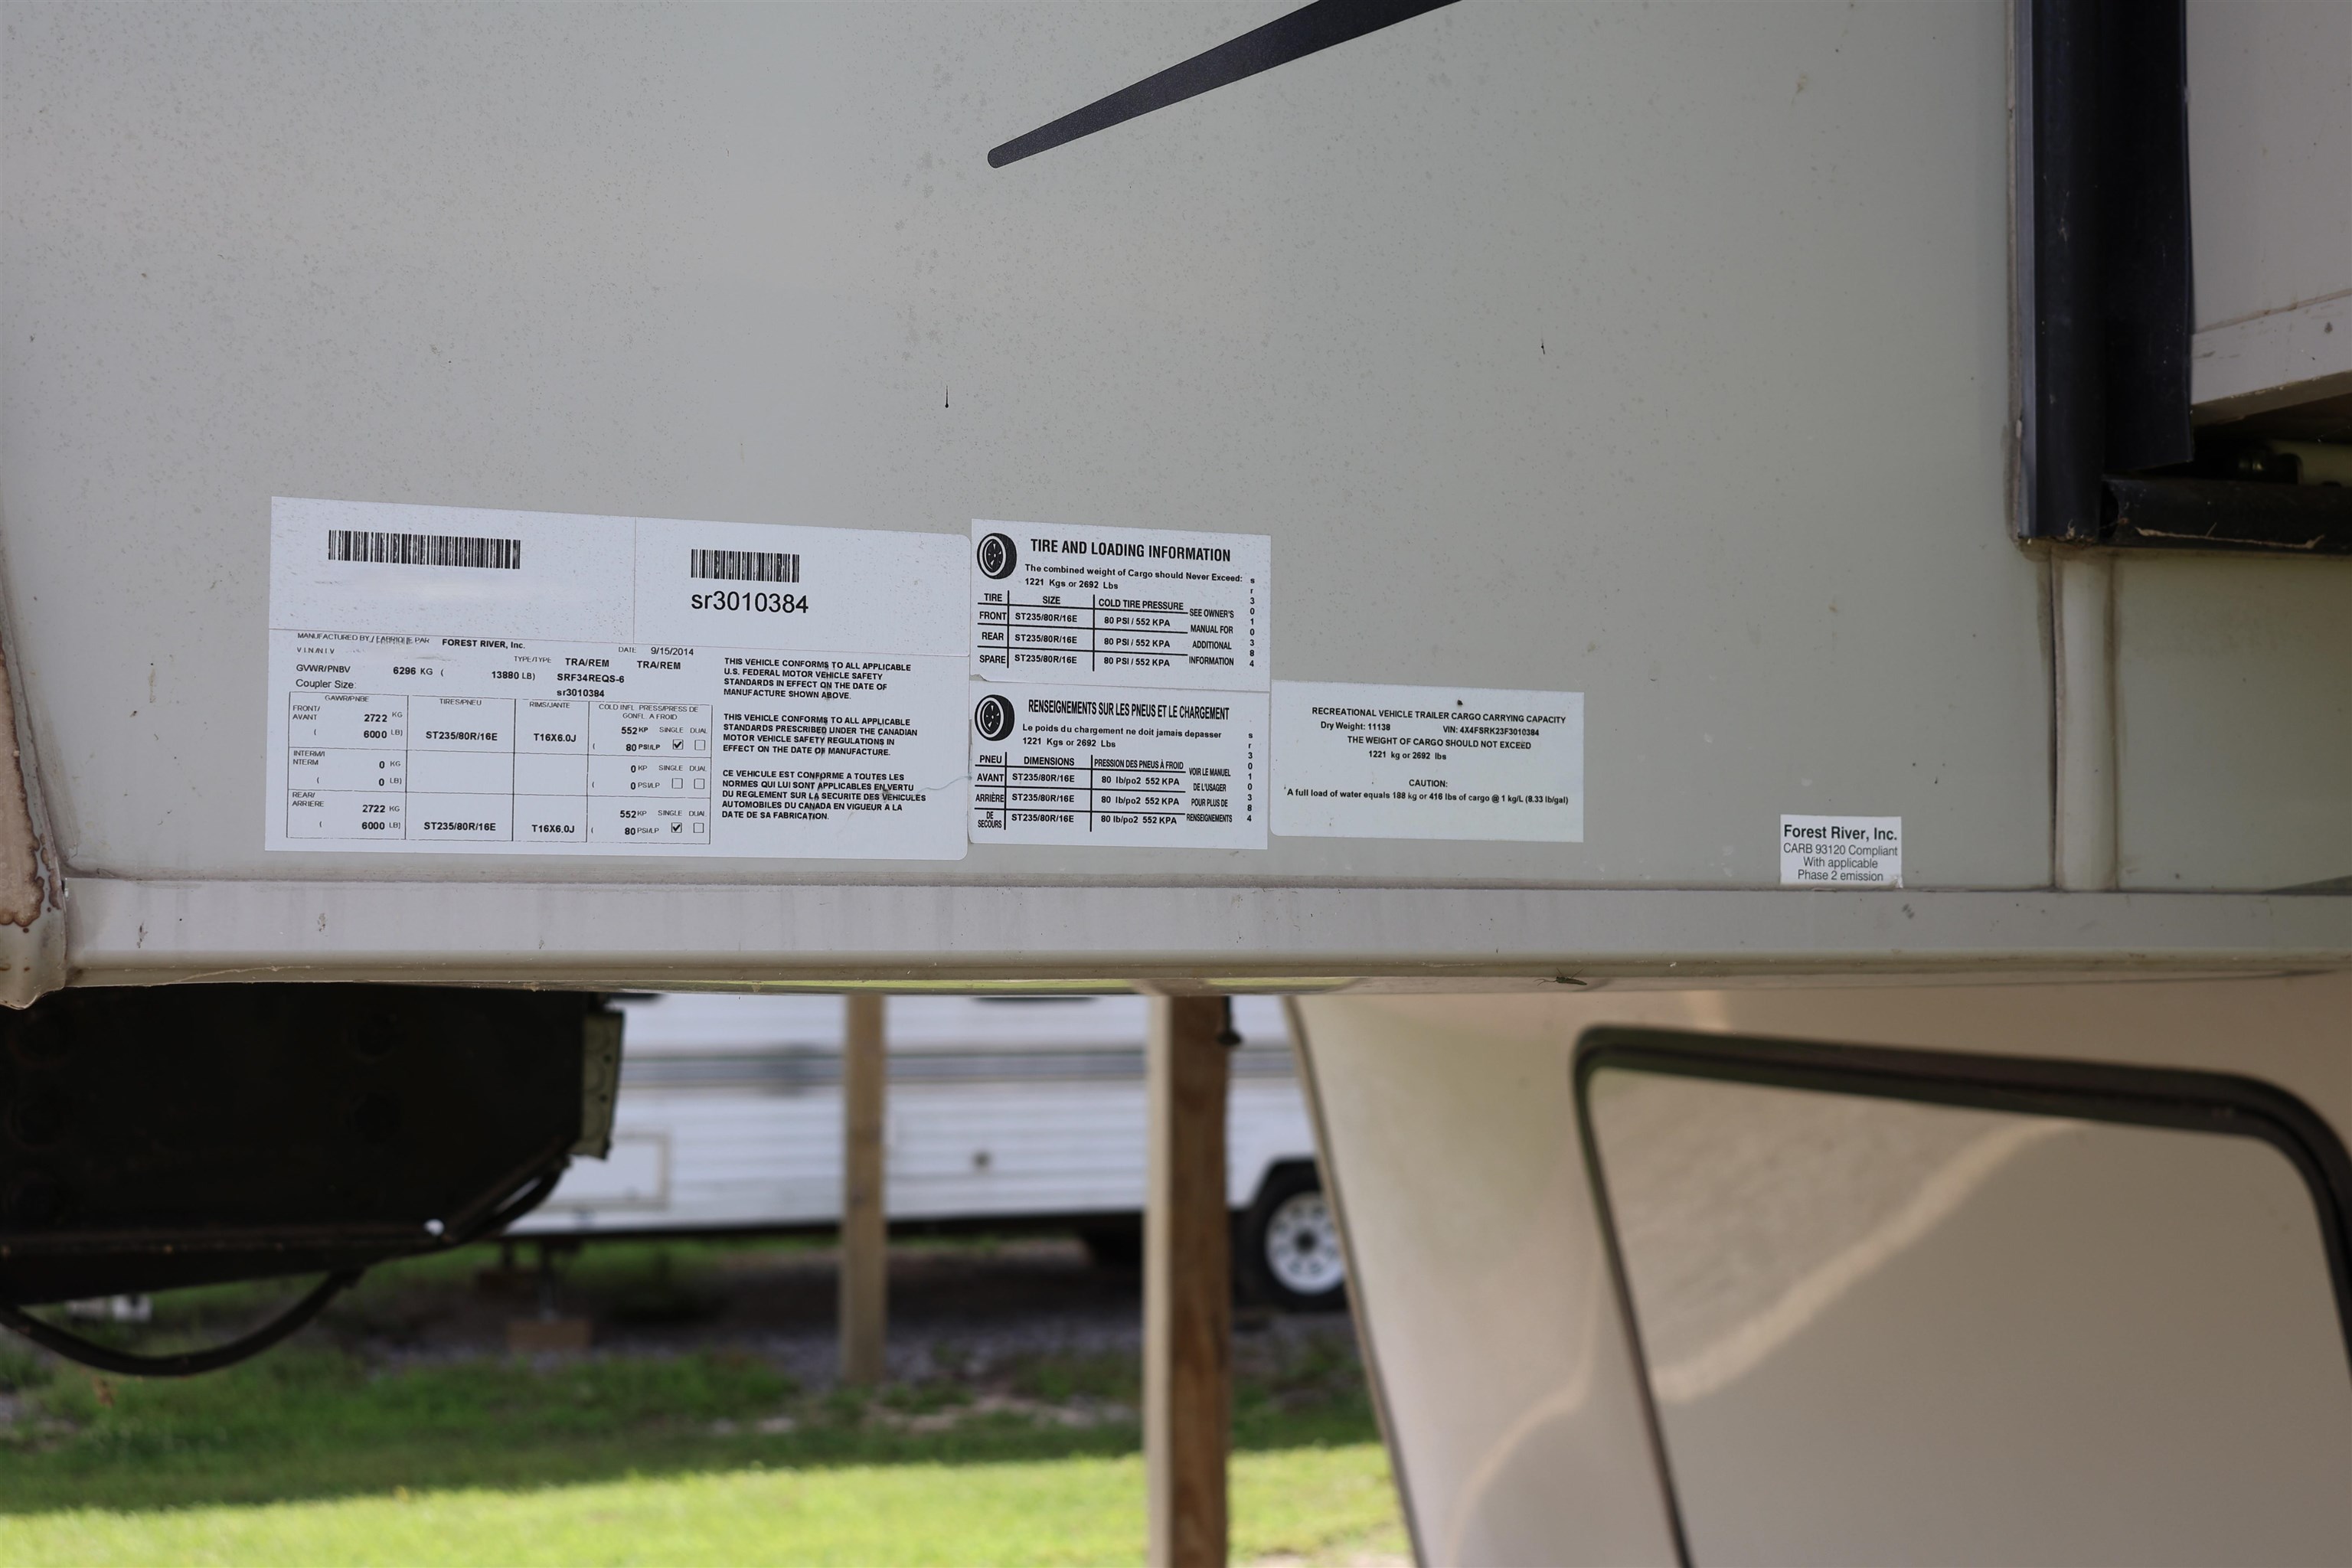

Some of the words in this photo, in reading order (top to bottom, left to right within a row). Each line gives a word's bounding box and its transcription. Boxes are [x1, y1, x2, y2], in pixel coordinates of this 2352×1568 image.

[1031, 539, 1058, 553] TIRE
[1062, 541, 1086, 554] AND
[1092, 542, 1144, 557] LOADING
[1149, 545, 1230, 561] INFORMATION
[1025, 564, 1041, 572] The
[1087, 567, 1115, 577] weight
[1128, 570, 1152, 579] Cargo
[1212, 573, 1242, 582] Exceed:
[1050, 579, 1066, 588] Kgs
[691, 591, 808, 613] sr3010384
[984, 593, 1002, 602] TIRE
[1043, 596, 1060, 604] SIZE
[1099, 599, 1121, 607] COLD
[1123, 599, 1140, 608] TIRE
[1142, 601, 1184, 610] PRESSURE
[980, 611, 1007, 620] FRONT
[1015, 612, 1077, 622] ST235/80R/16E
[1204, 609, 1234, 618] OWNER'S
[1191, 625, 1218, 633] MANUAL
[1220, 626, 1233, 634] FOR
[480, 640, 508, 648] RIVER,
[1193, 641, 1232, 649] ADDITIONAL
[651, 647, 694, 655] 9/15/2014
[565, 658, 609, 667] TRA/REM
[637, 661, 681, 669] TRA/REM
[782, 660, 828, 669] CONFORMS
[1189, 656, 1233, 665] INFORMATION
[296, 665, 351, 673] GVWR/PNBV
[522, 672, 535, 681] LB)
[557, 674, 624, 683] SRF34REQS-6
[296, 679, 332, 689] Coupler
[335, 680, 356, 688] Size:
[557, 688, 604, 697] sr3010384
[724, 688, 786, 697] MANUFACTURE
[822, 691, 851, 700] ABOVE.
[1029, 699, 1096, 714] RENSEIGNEMENTS
[1099, 702, 1114, 715] SUR
[1116, 703, 1129, 716] LES
[1132, 704, 1155, 717] PNEUS
[1158, 704, 1167, 717] ET
[1169, 705, 1178, 717] LE
[1180, 706, 1229, 720] CHARGEMENT
[364, 714, 387, 722] 2722
[1312, 707, 1377, 717] RECREATIONAL
[1379, 710, 1413, 718] VEHICLE
[1483, 714, 1524, 722] CARRYING
[1321, 721, 1334, 730] Dry
[1336, 722, 1365, 731] Weight:
[426, 731, 498, 740] ST235/80R/16E
[1035, 724, 1058, 733] poids
[1074, 726, 1123, 735] chargement
[1156, 729, 1182, 737] jamais
[1184, 730, 1221, 739] depasser
[1460, 727, 1539, 736] 4X4FSRK23F3010384
[534, 733, 576, 742] T16X6.0J
[1413, 738, 1443, 746] CARGO
[980, 755, 1001, 763] PNEU
[1391, 751, 1400, 760] kg
[1024, 756, 1074, 766] DIMENSIONS
[977, 773, 1004, 782] AVANT
[1012, 773, 1074, 782] ST235/80R/16E
[1364, 792, 1390, 800] equals
[1408, 792, 1416, 801] kg
[1491, 795, 1499, 803] @
[1508, 795, 1524, 804] kg/L
[1525, 795, 1543, 804] (8.33
[1545, 796, 1568, 805] lb/gal)
[1785, 825, 1826, 838] Forest
[1831, 826, 1869, 841] River,
[1874, 828, 1897, 840] Inc.
[1784, 843, 1812, 854] CARB
[1815, 844, 1845, 854] 93120
[1848, 844, 1897, 858] Compliant
[1804, 857, 1824, 867] With
[1828, 858, 1878, 870] applicable
[1798, 869, 1828, 880] Phase
[1831, 871, 1837, 880] 2
[1841, 871, 1883, 881] emission
